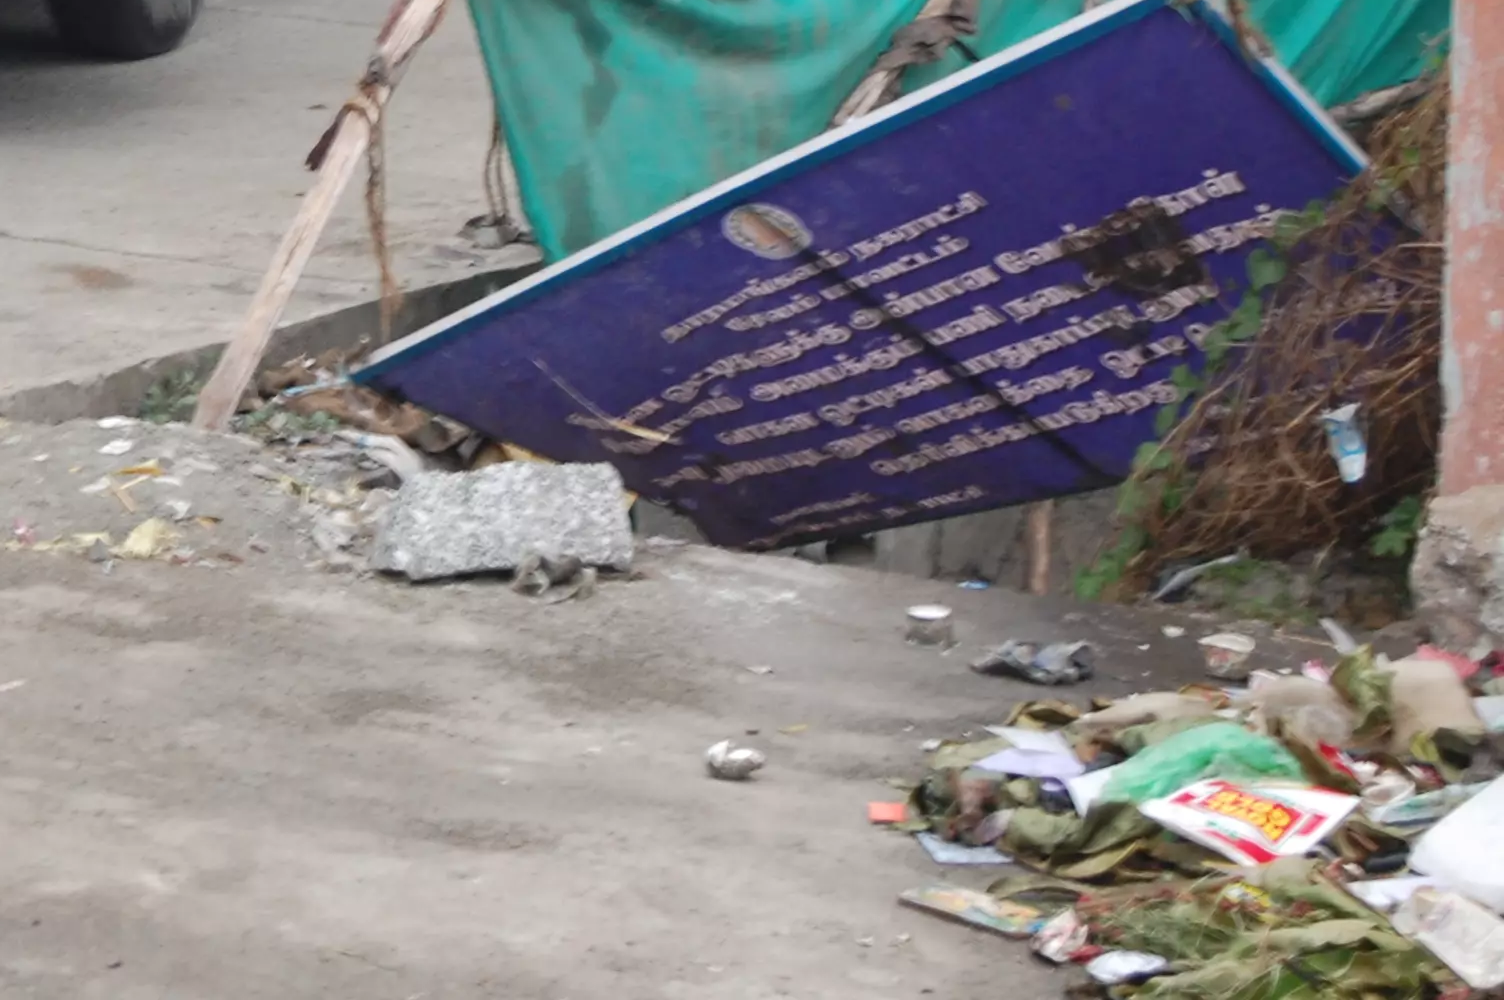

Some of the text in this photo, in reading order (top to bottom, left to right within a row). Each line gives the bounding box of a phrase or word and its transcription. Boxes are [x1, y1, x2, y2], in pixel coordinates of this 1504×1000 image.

[845, 189, 988, 261] நகராட்சி
[817, 234, 971, 301] மாவட்டம்
[921, 303, 1009, 346] பணி
